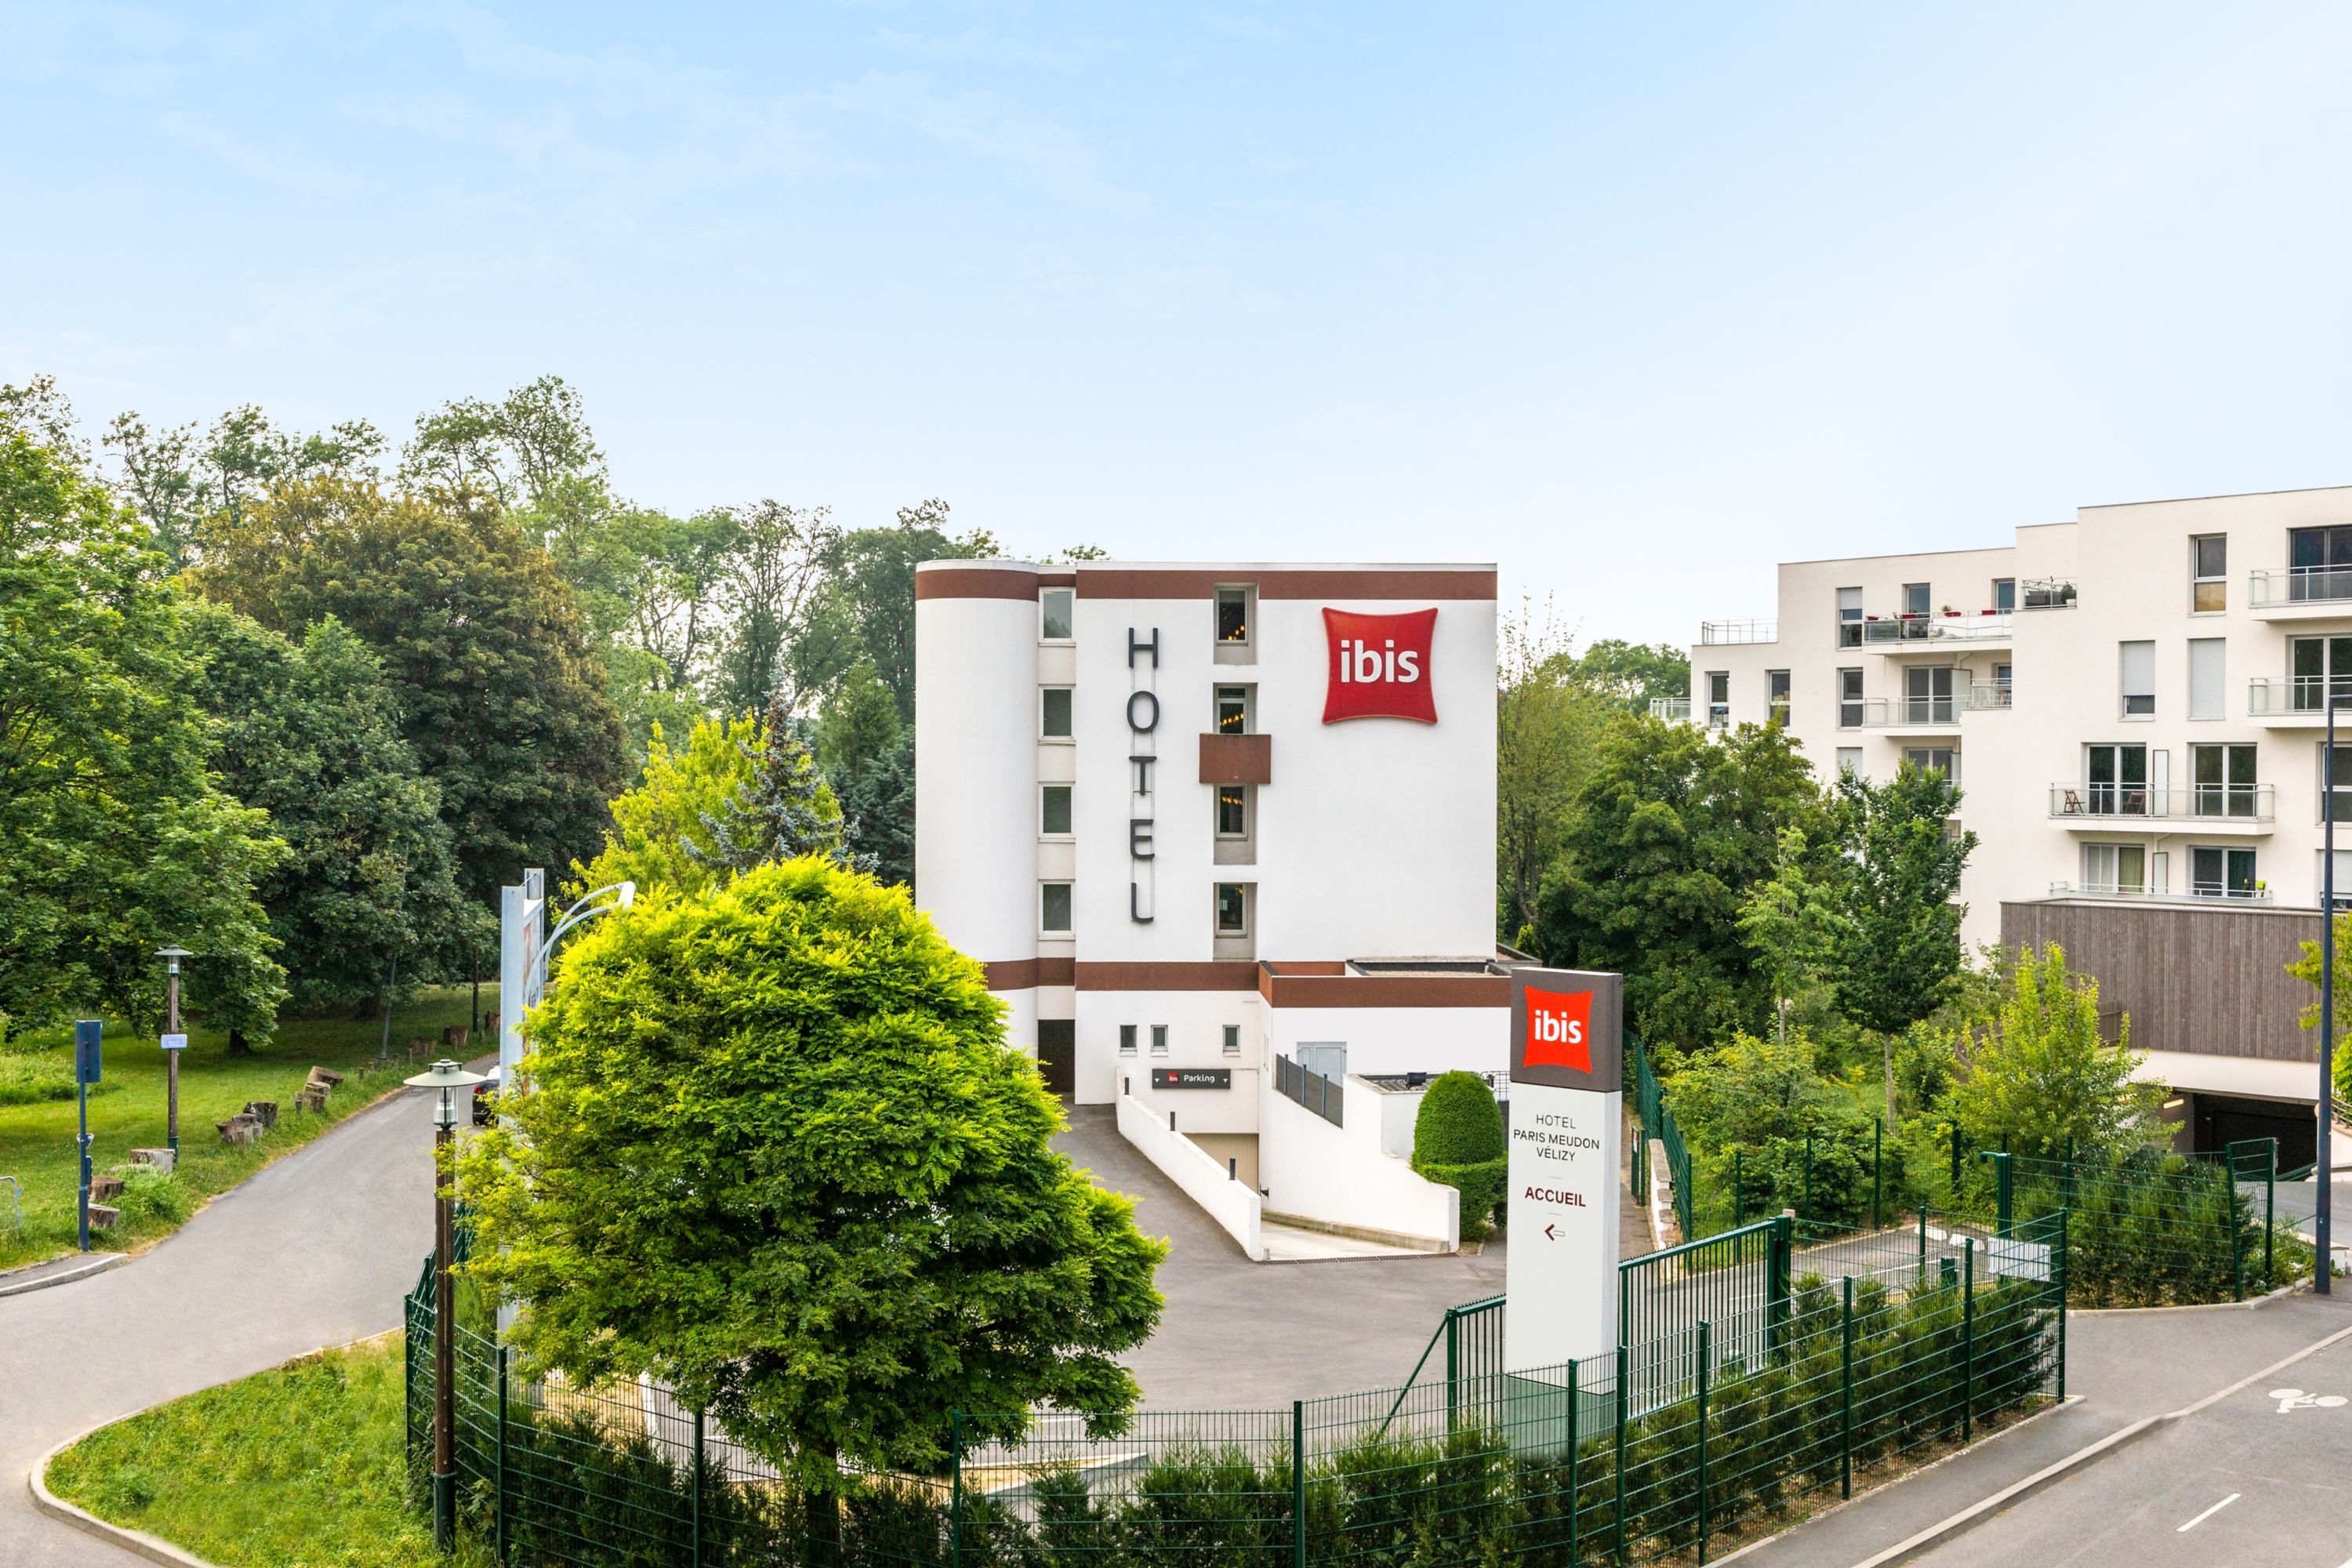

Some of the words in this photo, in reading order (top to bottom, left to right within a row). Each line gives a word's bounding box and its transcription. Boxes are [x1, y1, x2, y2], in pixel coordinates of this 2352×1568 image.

[1341, 639, 1420, 684] ibis
[1127, 627, 1160, 924] HOTEL
[1534, 1009, 1582, 1044] ibis
[1183, 1074, 1216, 1083] Parking
[1536, 1113, 1577, 1130] HOTEL
[1513, 1129, 1546, 1143] PARIS
[1548, 1134, 1600, 1150] MEUDON
[1536, 1145, 1576, 1162] VÉLIZY
[1524, 1186, 1587, 1208] ACCUEIL
